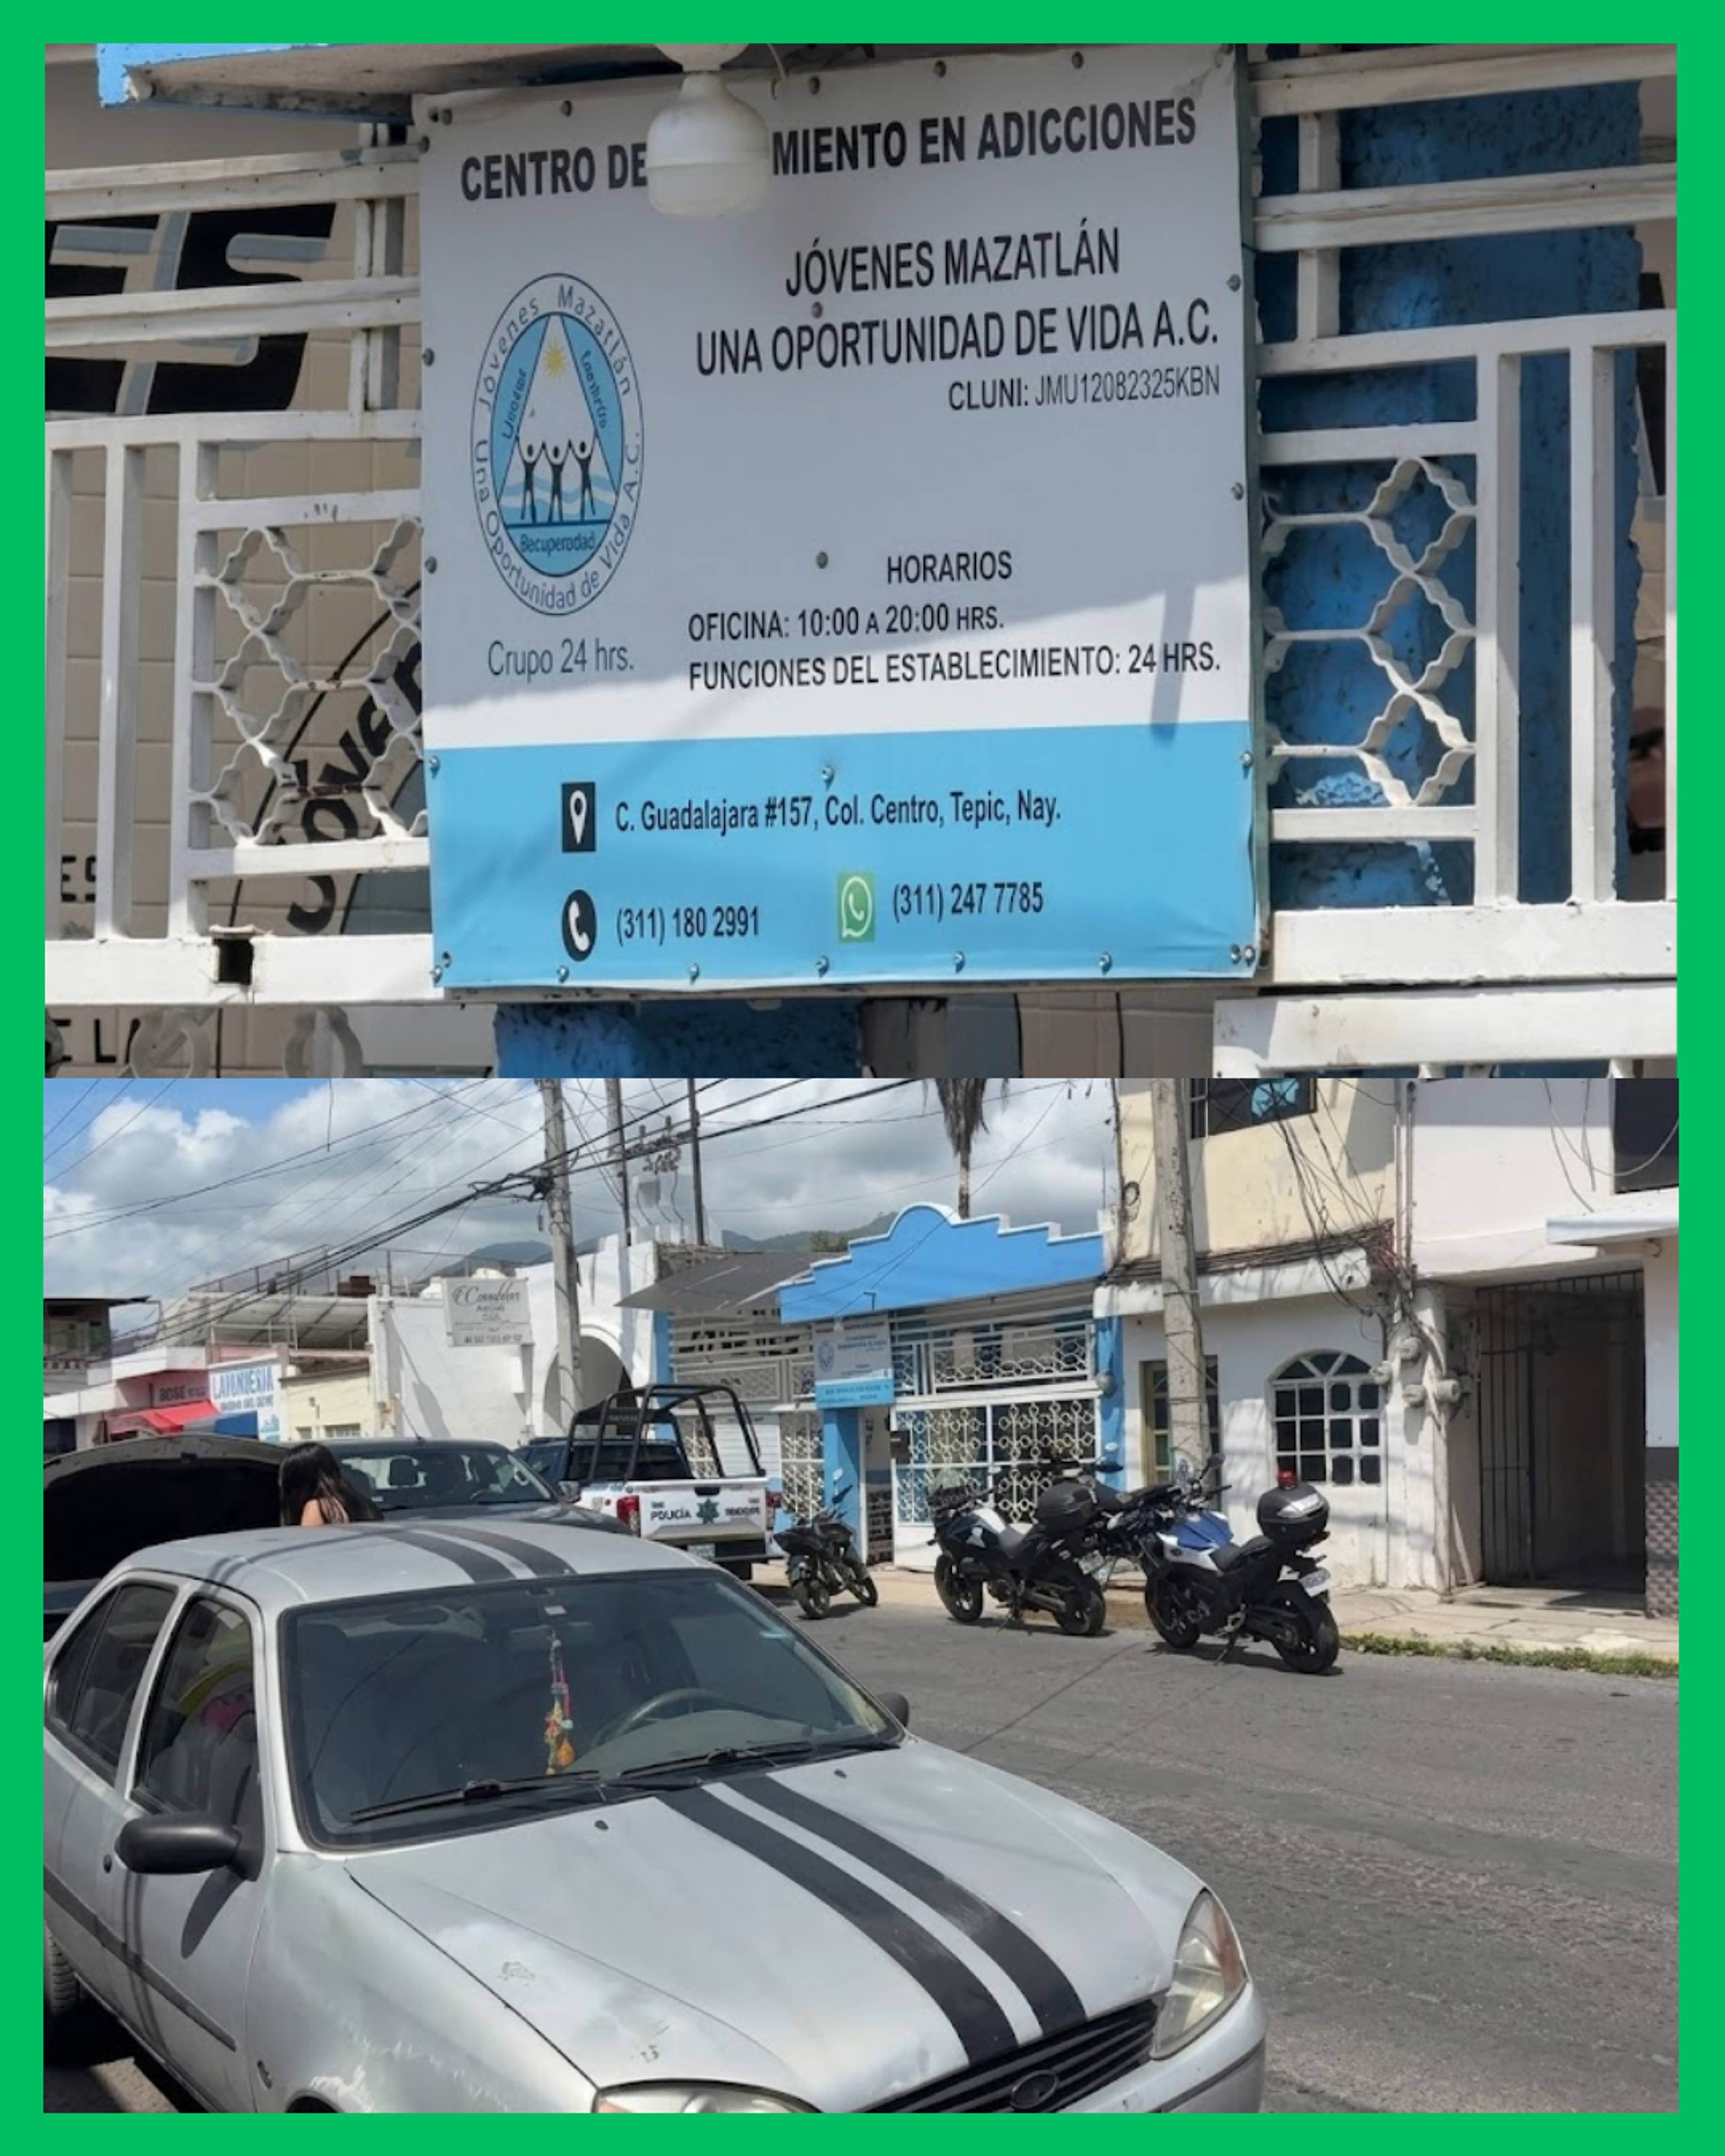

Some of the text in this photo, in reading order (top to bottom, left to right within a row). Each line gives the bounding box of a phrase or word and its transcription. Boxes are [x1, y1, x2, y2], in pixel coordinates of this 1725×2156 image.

[461, 97, 1195, 201] CENTRO DE MIENTO EN ADICCIONES
[786, 217, 1118, 296] JÓVENES MAZATLÁN
[698, 298, 1217, 376] UNA OPORTUNIDAD DE VIDA A.C.
[949, 365, 1219, 411] CLUNI: JMU12082325KBN
[474, 440, 490, 502] Una
[486, 511, 576, 610] Oportunidad
[580, 570, 600, 598] de
[599, 512, 631, 570] Vida
[888, 551, 1012, 584] HORARIOS
[689, 603, 1003, 641] OFICINA: 10:00 A 20:00 HRS.
[561, 638, 587, 673] 24
[595, 638, 633, 671] hrs.
[690, 642, 1219, 689] FUNCIONES DEL ESTABLECIMIENTO: 24 HRS.
[616, 790, 1060, 836] C. Guadalajara #157, Col. Centro, Tepic, Nay.
[893, 882, 1043, 923] (311) 247 7785
[617, 906, 758, 946] (311) 180 2991
